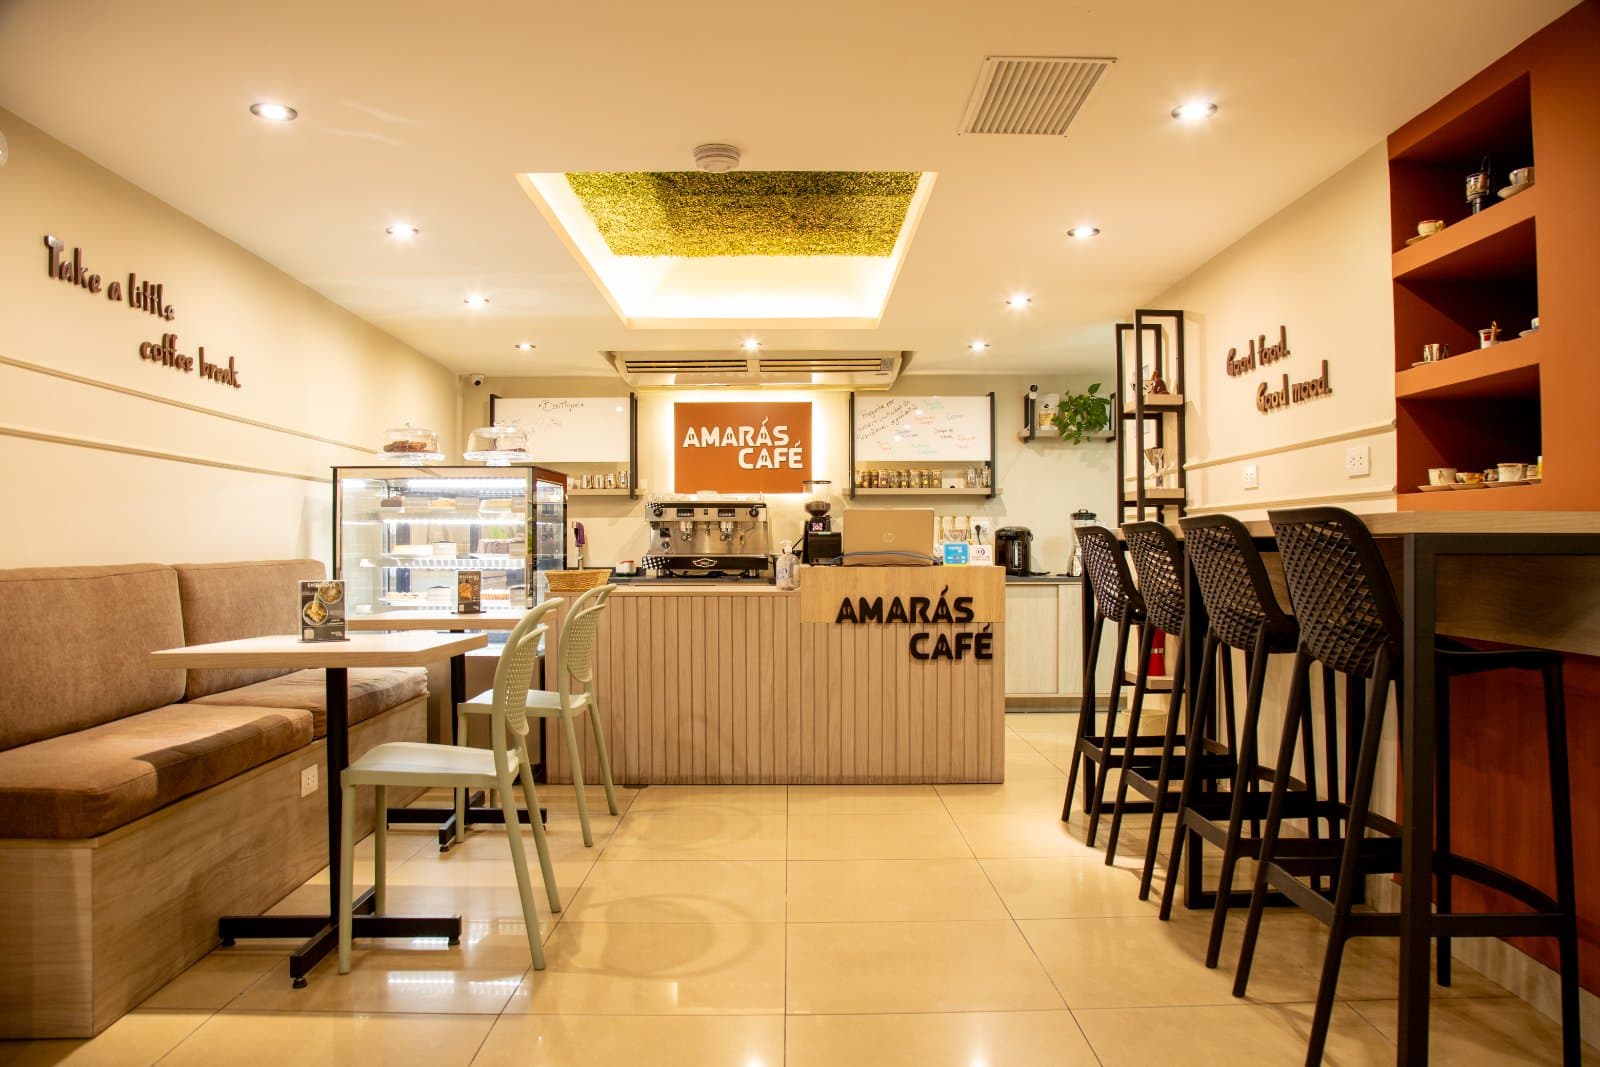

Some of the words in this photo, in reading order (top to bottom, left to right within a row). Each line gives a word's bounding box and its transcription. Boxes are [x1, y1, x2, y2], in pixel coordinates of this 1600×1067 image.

[44, 235, 102, 293] Take
[107, 281, 122, 301] a
[128, 272, 175, 321] little
[139, 333, 194, 374] coffee
[198, 346, 241, 389] break.
[1226, 339, 1256, 376] Good
[1257, 325, 1291, 366] food.
[1256, 373, 1290, 412] Good
[1291, 359, 1333, 403] mood.
[682, 416, 790, 448] AMARÁS
[738, 440, 803, 469] CAFÉ
[835, 584, 975, 624] AMARÁS
[909, 622, 993, 660] CAFÉ
